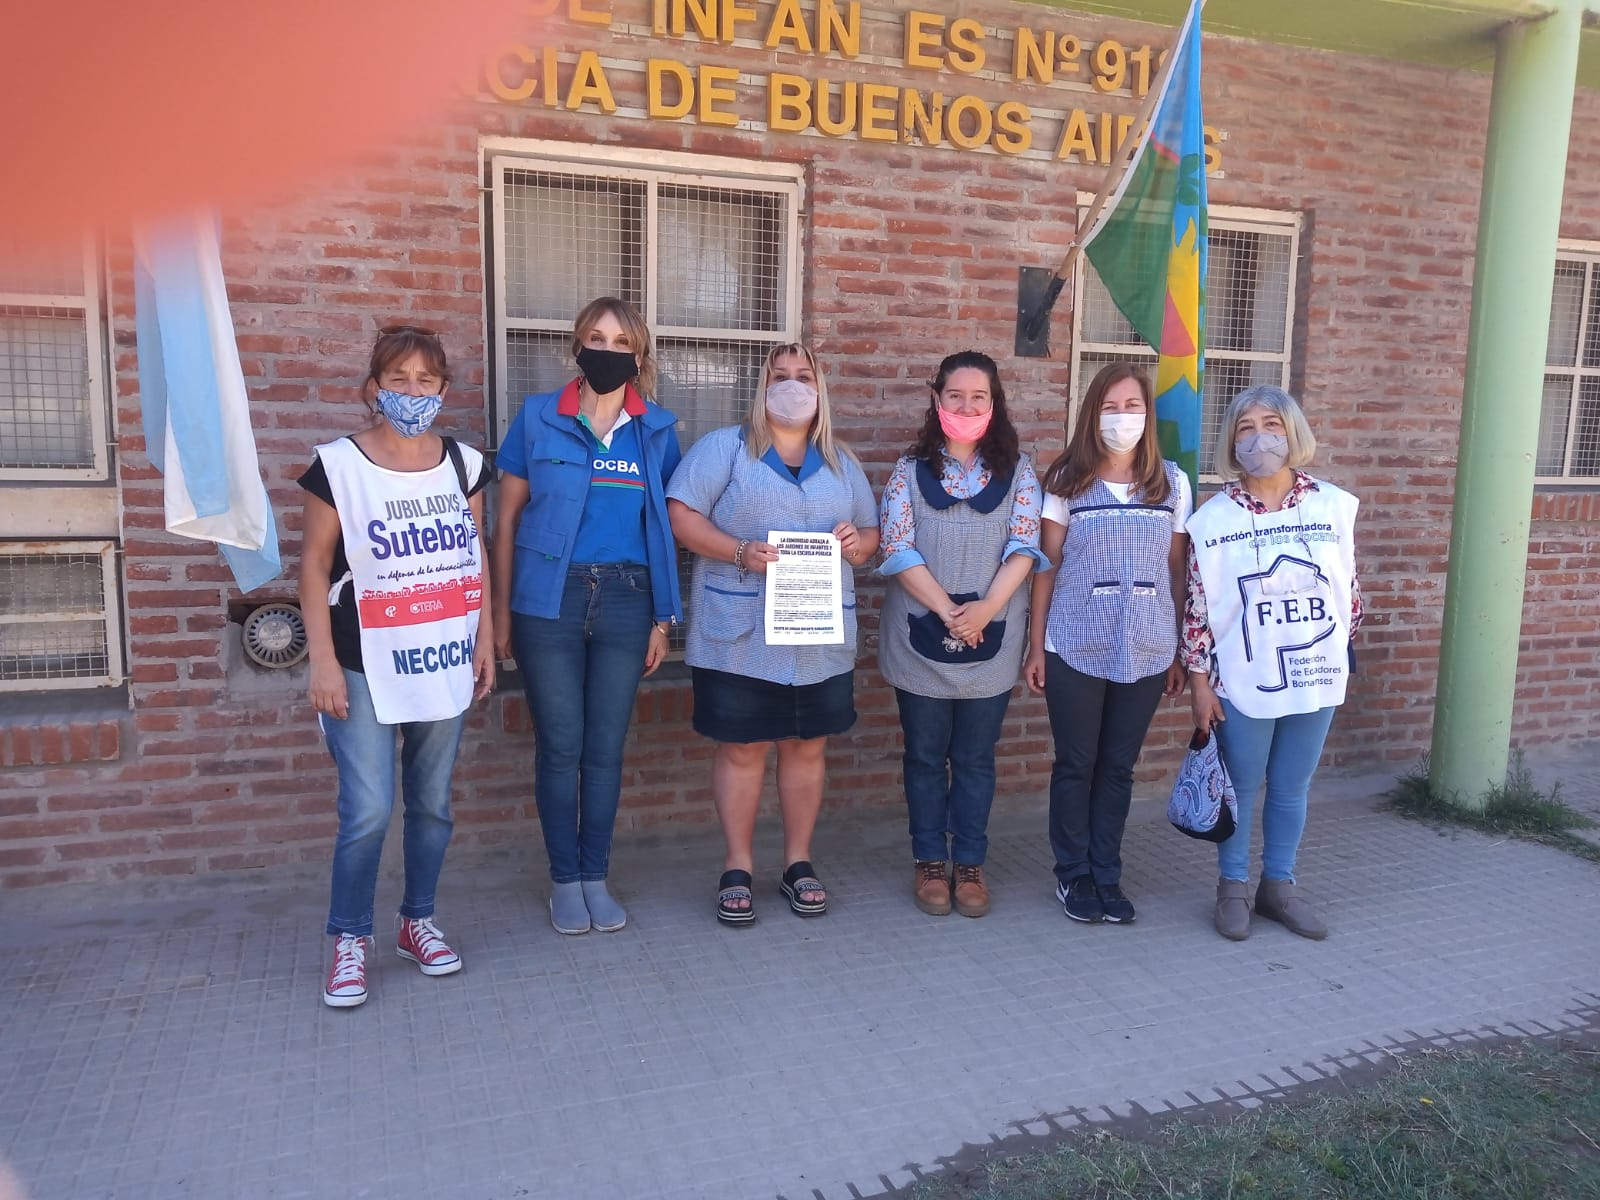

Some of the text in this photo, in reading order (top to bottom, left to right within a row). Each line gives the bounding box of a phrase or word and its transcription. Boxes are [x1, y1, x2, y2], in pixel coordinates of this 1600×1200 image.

[1092, 39, 1169, 98] 91
[647, 58, 740, 128] DE
[769, 72, 1033, 155] BUENOS
[592, 458, 641, 476] OCBA
[367, 518, 467, 560] Suteba
[1205, 522, 1332, 549] La acción transformadora
[1248, 537, 1267, 549] de
[1270, 534, 1291, 546] los
[388, 570, 415, 582] defensa
[417, 567, 425, 576] de
[427, 565, 434, 574] la
[1255, 597, 1334, 626] F.E.B.
[392, 634, 473, 675] NECOCH
[1290, 668, 1302, 677] de
